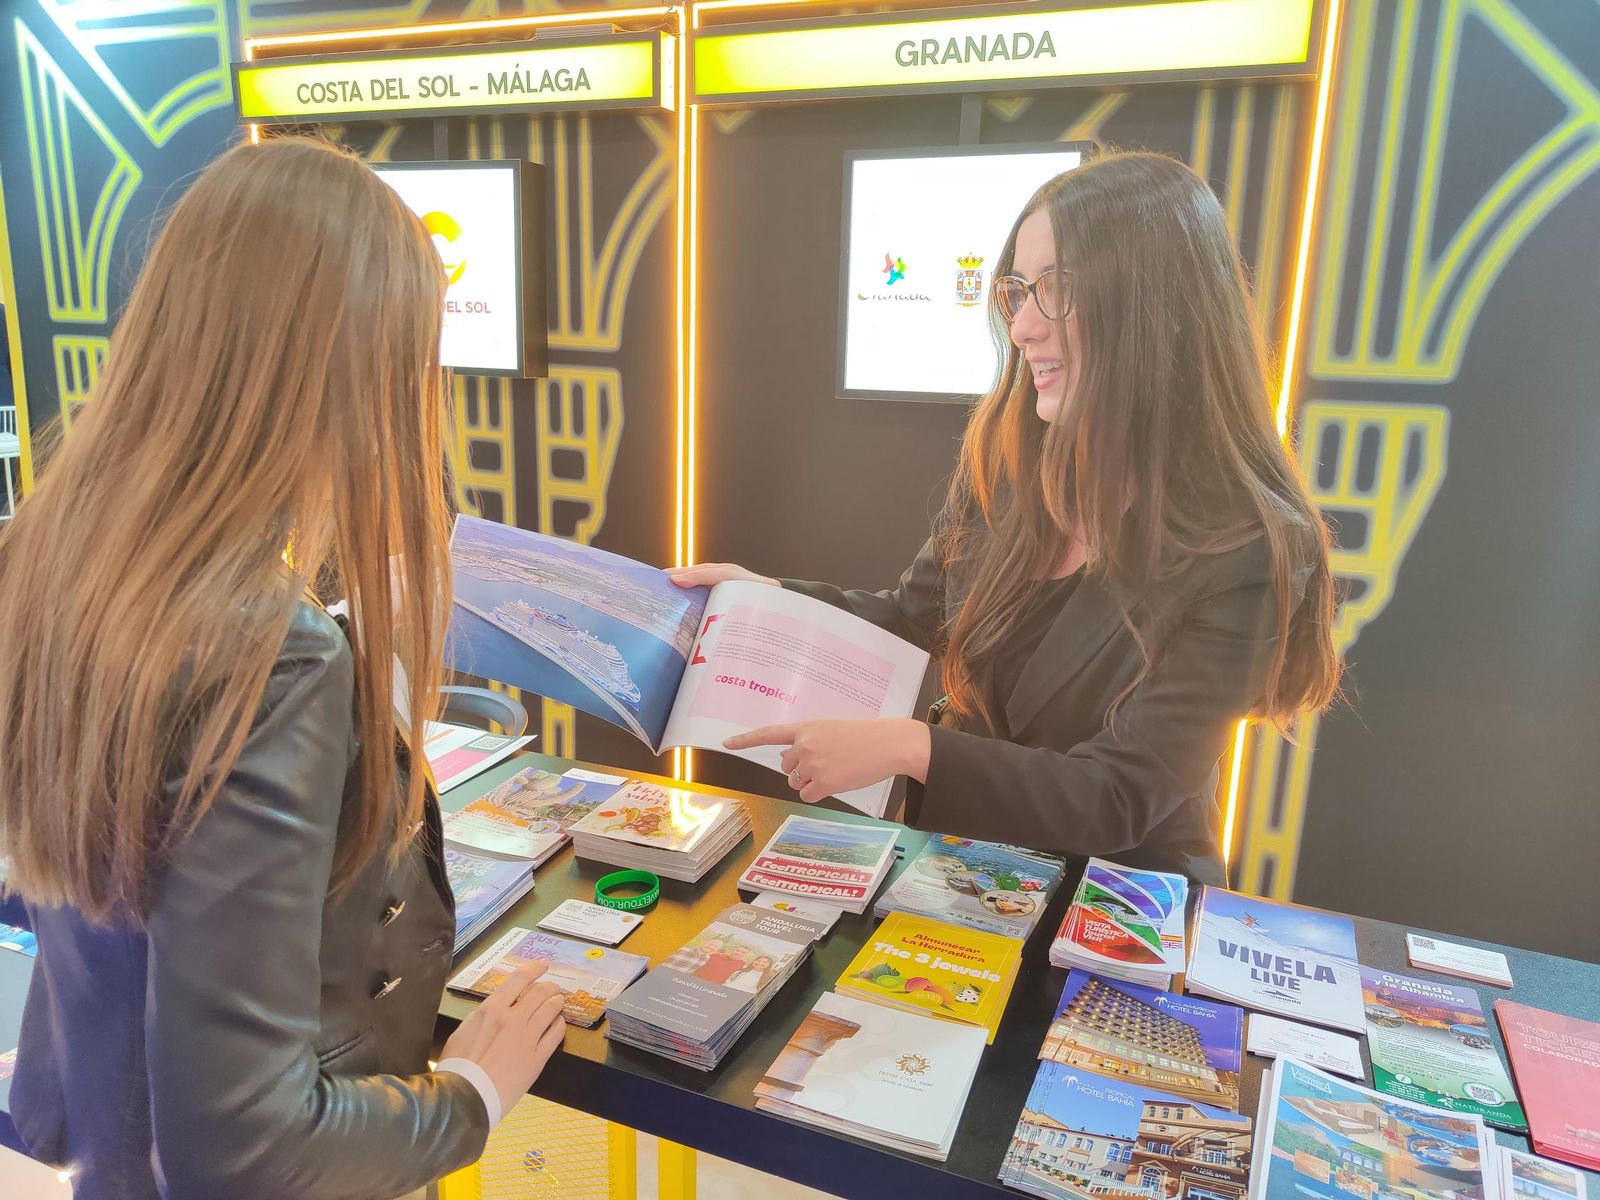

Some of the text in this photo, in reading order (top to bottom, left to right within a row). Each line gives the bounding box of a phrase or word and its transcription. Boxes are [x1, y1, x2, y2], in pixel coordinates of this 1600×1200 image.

[895, 30, 1057, 67] GRANADA
[296, 80, 363, 105] COSTA
[370, 77, 410, 102] DEL
[418, 74, 461, 99] SOL
[487, 63, 592, 95] MÁLAGA
[465, 301, 492, 314] SOL
[715, 674, 798, 705] costa tropical
[761, 860, 866, 882] FeelTROPICAL!
[751, 874, 859, 897] FeelTROPICAL!
[754, 923, 781, 935] TOUR
[759, 919, 793, 933] TRAVEL
[763, 915, 816, 933] ANDALUSIA
[1085, 919, 1111, 930] VISITA
[530, 933, 562, 946] JUST
[1083, 929, 1115, 940] Tourist
[517, 945, 558, 960] CLICK
[901, 936, 986, 963] La Herradura
[874, 941, 1002, 983] The 3 jewels
[1250, 967, 1301, 991] LIVE
[1382, 974, 1453, 996] Granada
[1400, 985, 1465, 1004] Alhambra
[1167, 1003, 1192, 1014] HOTEL
[900, 1076, 917, 1084] CASA
[1076, 1085, 1106, 1100] HOTEL
[1454, 1101, 1513, 1120] NATURANDA
